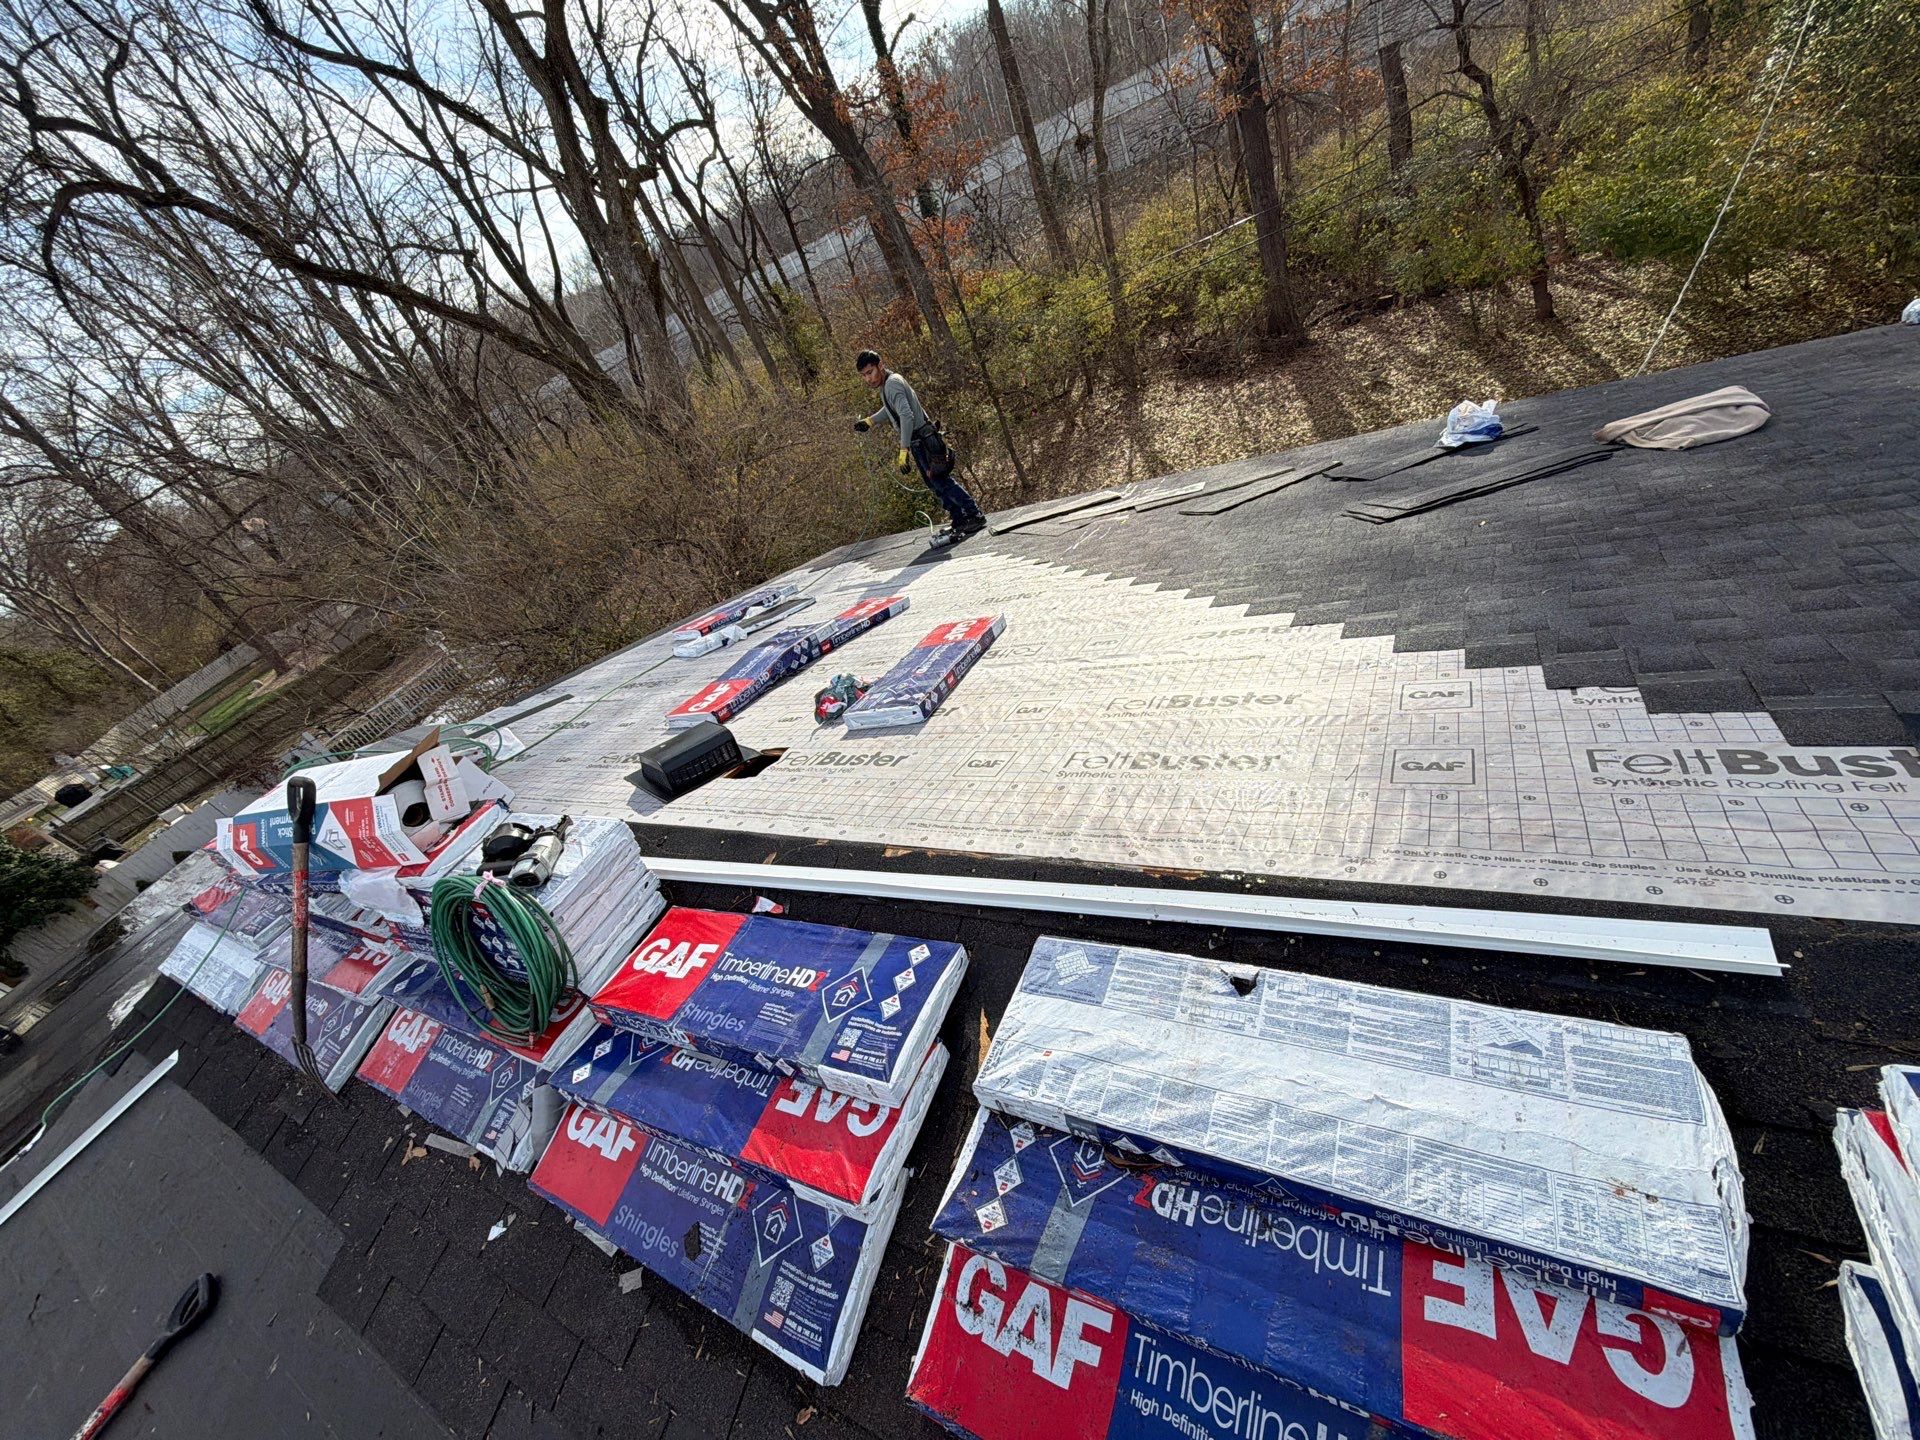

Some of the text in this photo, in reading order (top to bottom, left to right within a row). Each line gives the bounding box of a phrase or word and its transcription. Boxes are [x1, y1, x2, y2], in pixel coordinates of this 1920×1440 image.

[1105, 691, 1303, 711] FeltBuster
[1408, 690, 1465, 699] GAF
[1572, 697, 1645, 707] Synthe
[778, 751, 909, 768] FeltBuster
[968, 759, 1002, 768] GAF
[1063, 751, 1281, 771] FeltBuster
[1400, 761, 1466, 772] GAF
[1586, 748, 1920, 779] FeltBust
[1056, 770, 1117, 779] Synthetic
[1592, 776, 1909, 794] Synthetic Roofing Felt
[239, 828, 264, 866] GAF
[1403, 849, 1430, 857] ONLY
[1470, 854, 1492, 862] Cap
[1494, 855, 1522, 864] Nails
[1540, 857, 1579, 868] Plastic
[1582, 860, 1606, 870] Cap
[1608, 861, 1656, 872] Staples
[1675, 866, 1701, 874] Use
[1750, 870, 1815, 882] Puntillas
[632, 938, 720, 980] GAF
[711, 972, 724, 982] High
[770, 986, 796, 998] Shingles
[387, 1009, 440, 1054] GAF
[682, 1002, 747, 1033] Shingles
[640, 1162, 652, 1178] High
[651, 1170, 676, 1194] Definition
[699, 1197, 725, 1217] Shingles
[615, 1204, 679, 1258] Shingles
[770, 1223, 778, 1235] 4
[1375, 1210, 1617, 1292] High Definition Lifetime Shingles
[955, 1252, 1114, 1391] GAF
[1424, 1257, 1695, 1409] GAF
[1129, 1387, 1160, 1416] High
